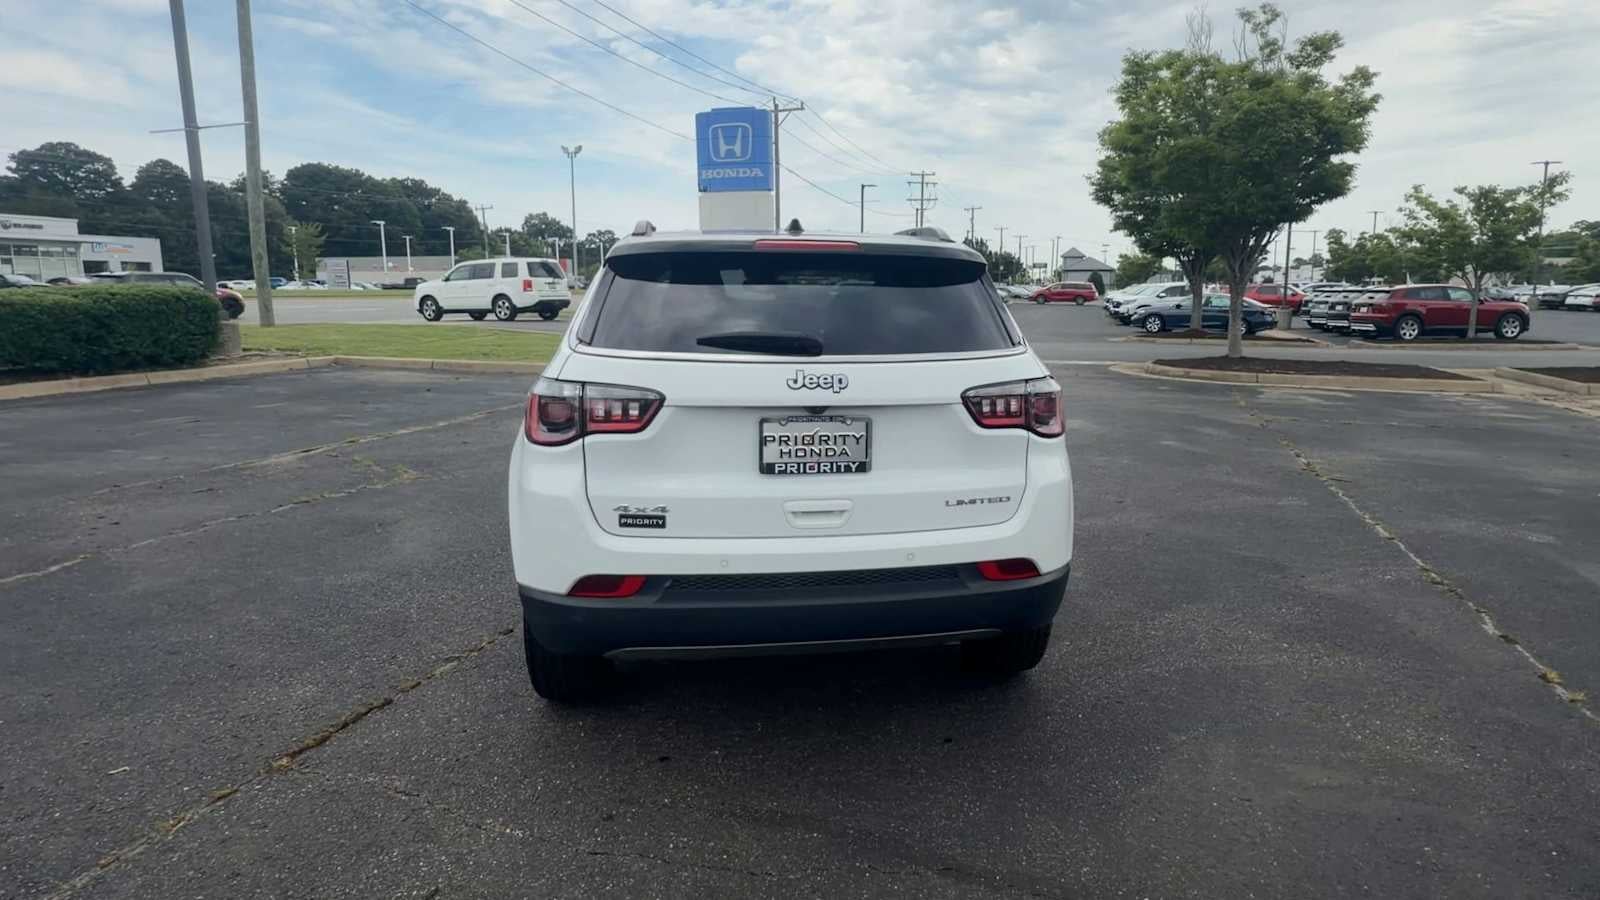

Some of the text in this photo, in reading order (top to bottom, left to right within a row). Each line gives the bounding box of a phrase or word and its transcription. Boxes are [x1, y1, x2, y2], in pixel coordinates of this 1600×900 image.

[702, 168, 764, 178] HONDA
[786, 369, 849, 393] Jeep
[763, 430, 864, 446] PRIORITY
[779, 446, 852, 458] HONDA
[774, 461, 860, 473] PRIORITY
[945, 496, 1010, 507] LIMITED
[620, 518, 664, 526] PRIORITY
